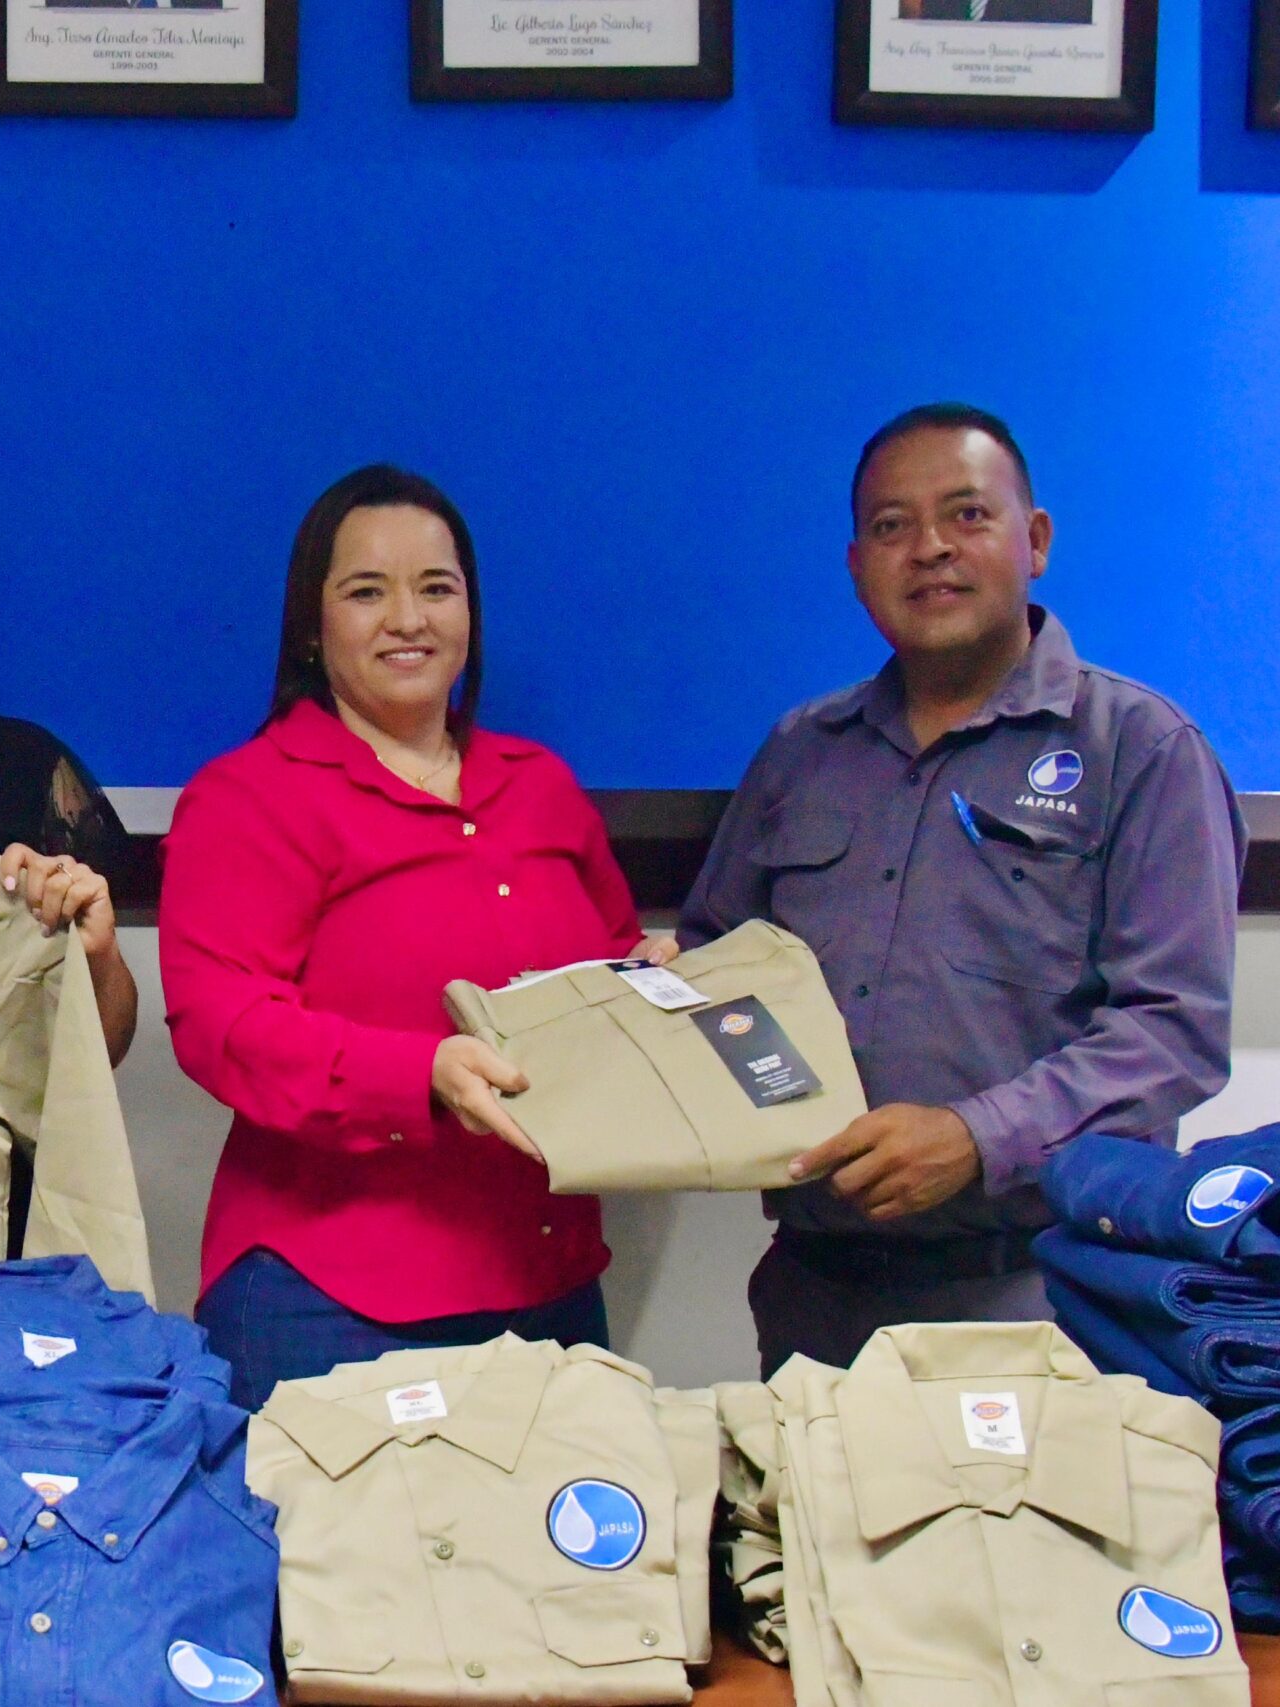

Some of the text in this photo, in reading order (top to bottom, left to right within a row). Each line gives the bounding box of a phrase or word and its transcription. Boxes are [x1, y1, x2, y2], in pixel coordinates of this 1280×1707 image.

[515, 14, 564, 34] Gilberto
[568, 12, 597, 35] Lugo
[95, 26, 148, 44] Amadeo
[186, 27, 245, 48] Montoya
[528, 36, 611, 45] GERENTE GENERAL
[93, 50, 175, 59] GERENTE GENERAL
[952, 63, 1033, 74] GERENTE GENERAL
[1014, 794, 1078, 815] JAPASA
[599, 1521, 635, 1537] JAPASA
